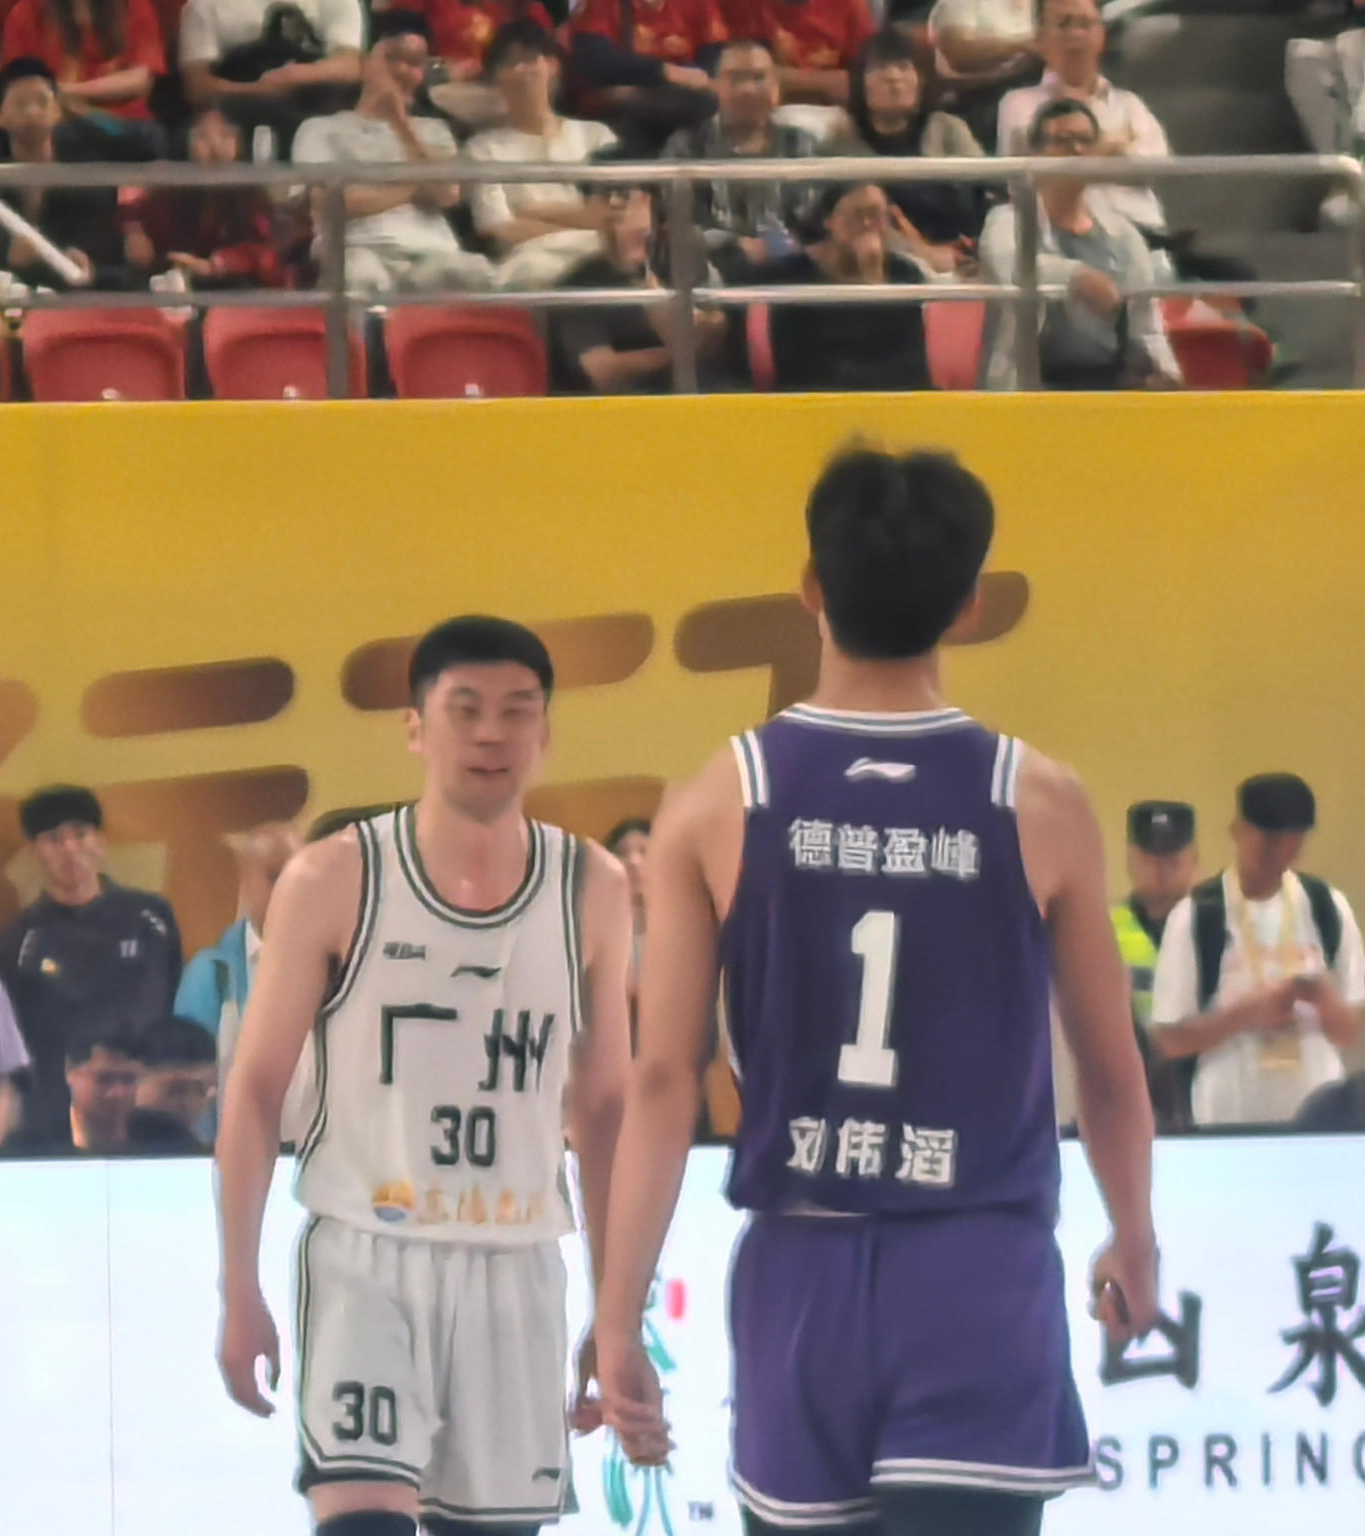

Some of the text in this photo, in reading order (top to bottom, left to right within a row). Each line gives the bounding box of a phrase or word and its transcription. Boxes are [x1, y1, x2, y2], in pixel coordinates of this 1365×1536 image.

[788, 817, 980, 880] 德普盈峰
[838, 911, 899, 1087] 1
[380, 1003, 556, 1092] 广州
[430, 1105, 496, 1167] 30
[331, 1381, 398, 1446] 30
